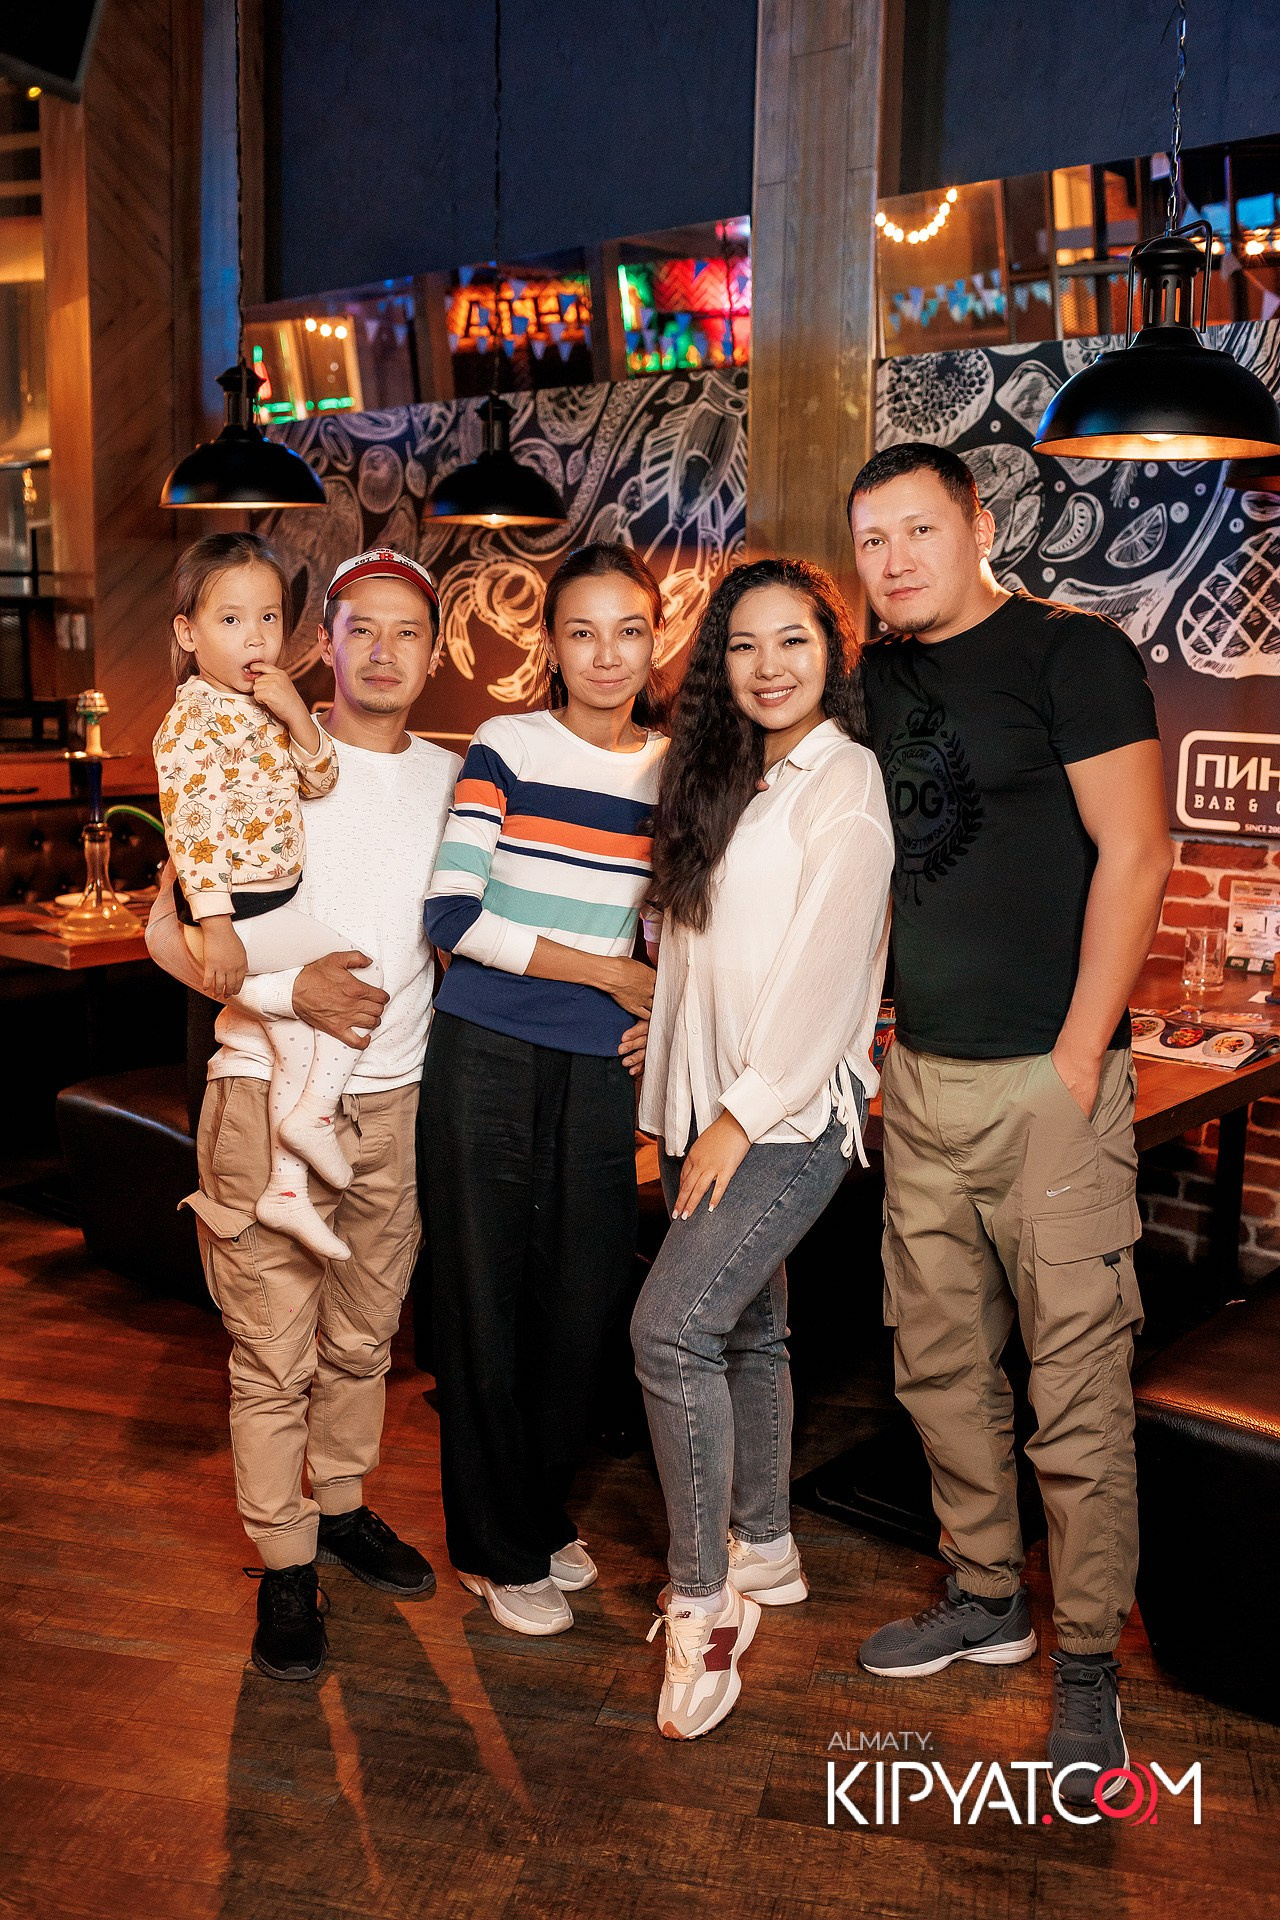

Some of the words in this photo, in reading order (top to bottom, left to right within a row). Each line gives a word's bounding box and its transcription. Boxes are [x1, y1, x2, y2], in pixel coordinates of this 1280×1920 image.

[895, 780, 944, 819] DG
[1194, 794, 1236, 812] BAR
[1248, 798, 1259, 813] &
[1245, 822, 1267, 834] SINCE
[1082, 1672, 1099, 1680] NIKE
